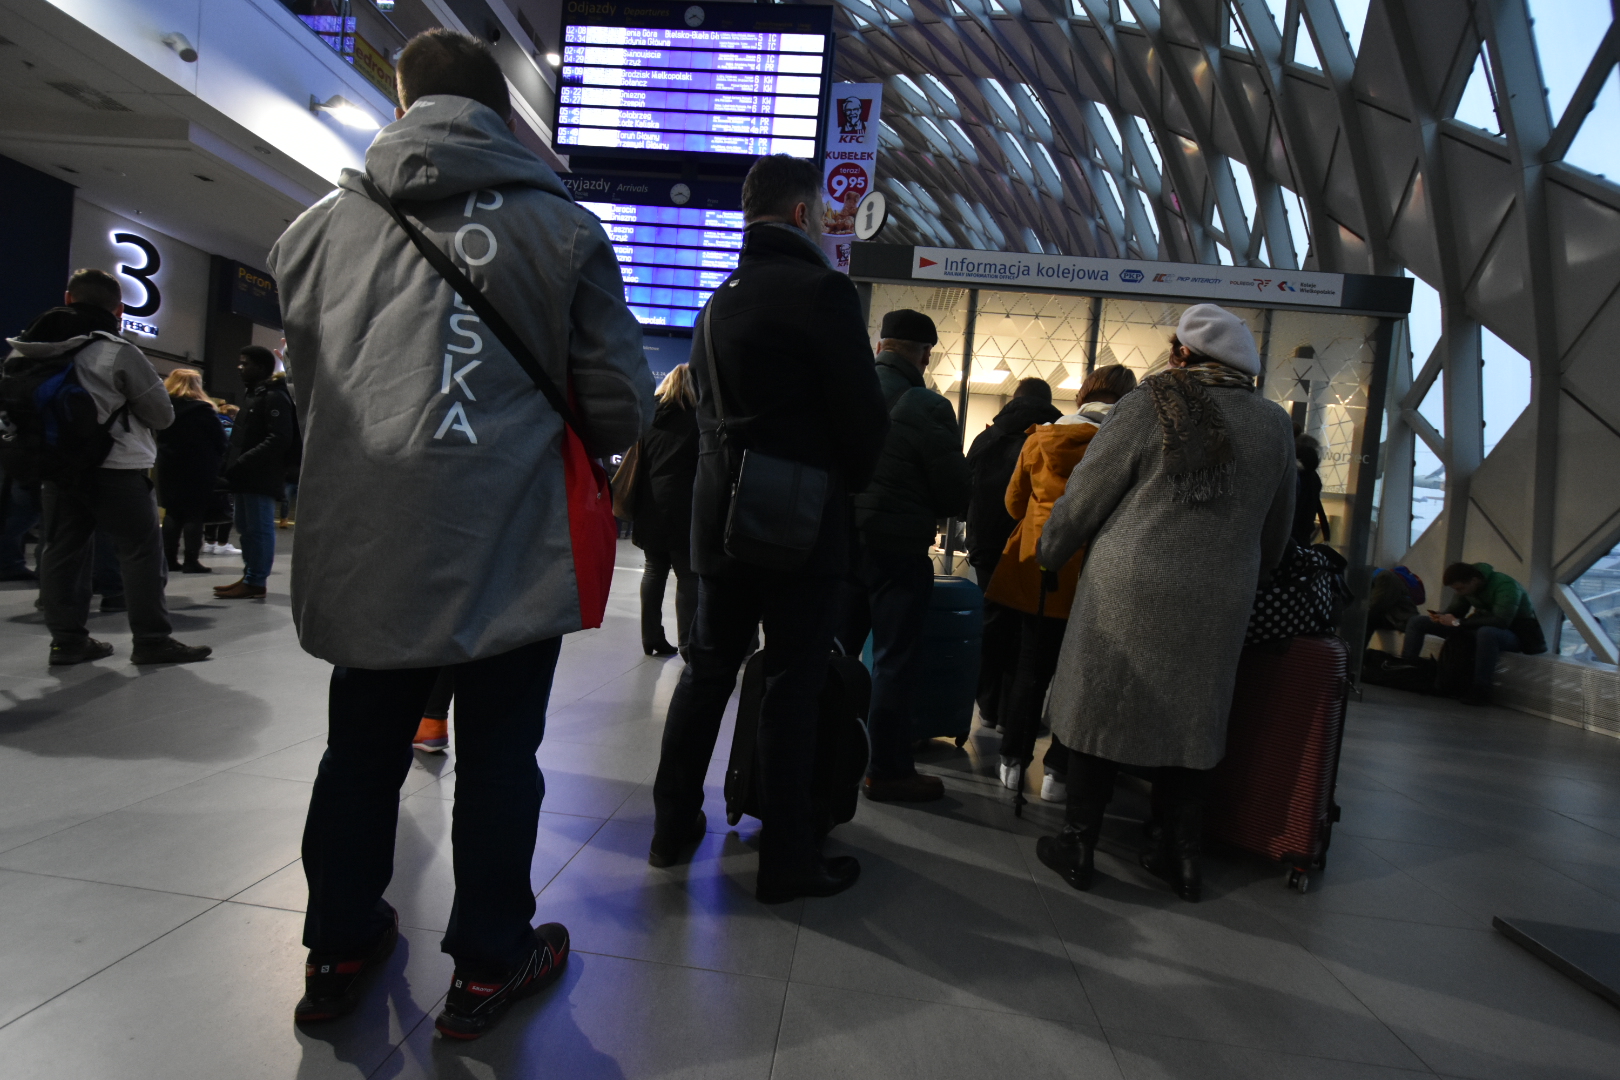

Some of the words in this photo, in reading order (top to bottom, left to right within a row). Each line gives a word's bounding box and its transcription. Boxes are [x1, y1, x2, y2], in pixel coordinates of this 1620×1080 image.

[567, 1, 617, 17] Odjazdy
[623, 7, 670, 17] Departures
[768, 34, 777, 42] IC
[767, 42, 776, 51] IC
[766, 55, 775, 63] IC
[838, 135, 864, 144] KFC
[825, 151, 875, 161] KUBEŁEK
[562, 178, 611, 193] rzyjazdy
[617, 183, 649, 194] Arrivals
[944, 257, 1030, 279] Informacja
[1037, 263, 1109, 283] kolejowa
[113, 232, 161, 318] 3
[238, 267, 272, 291] Peron
[965, 272, 998, 280] INFORMATION
[1191, 277, 1223, 285] INTERCITY
[1300, 287, 1336, 296] Wielkopolskie
[1322, 452, 1370, 464] worzec
